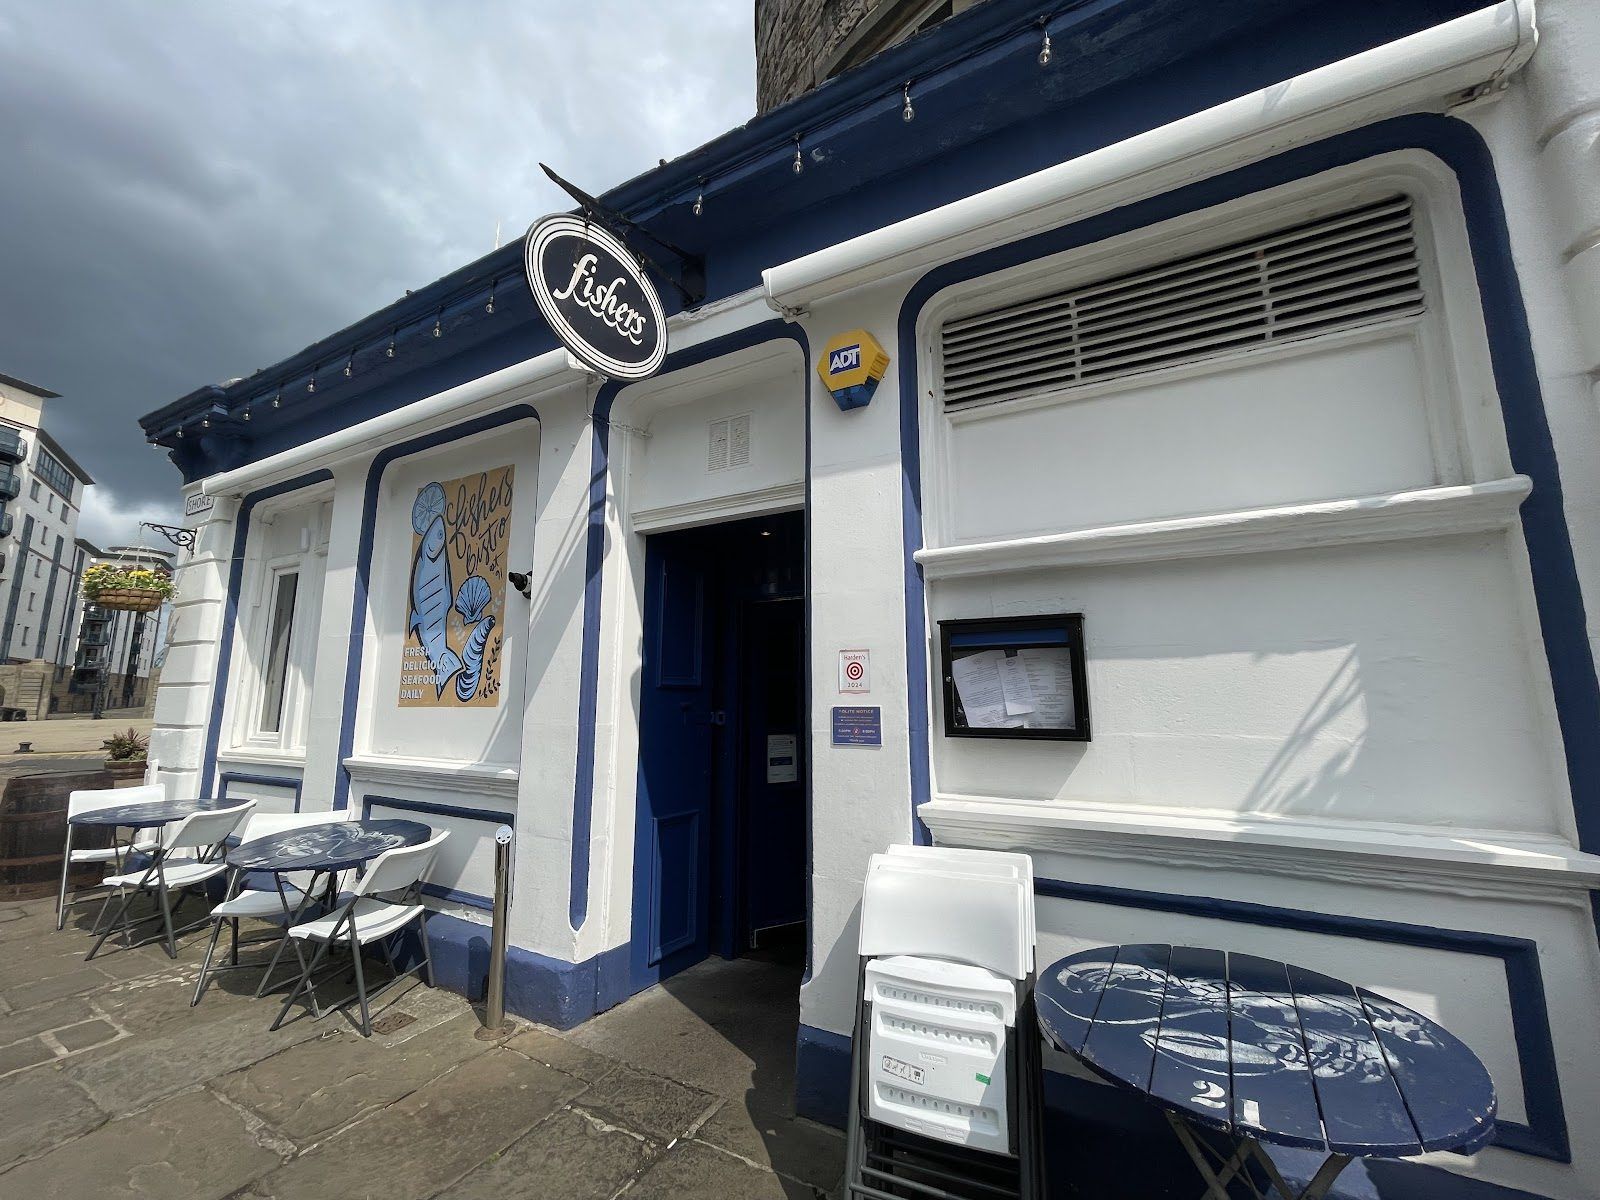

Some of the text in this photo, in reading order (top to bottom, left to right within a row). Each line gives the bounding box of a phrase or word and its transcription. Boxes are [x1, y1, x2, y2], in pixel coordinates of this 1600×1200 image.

[553, 253, 646, 345] fishers
[829, 347, 860, 371] ADT
[188, 496, 211, 511] SHORE
[404, 646, 432, 657] FRESH
[401, 674, 441, 686] SEAFOOD
[400, 688, 424, 700] DAILY
